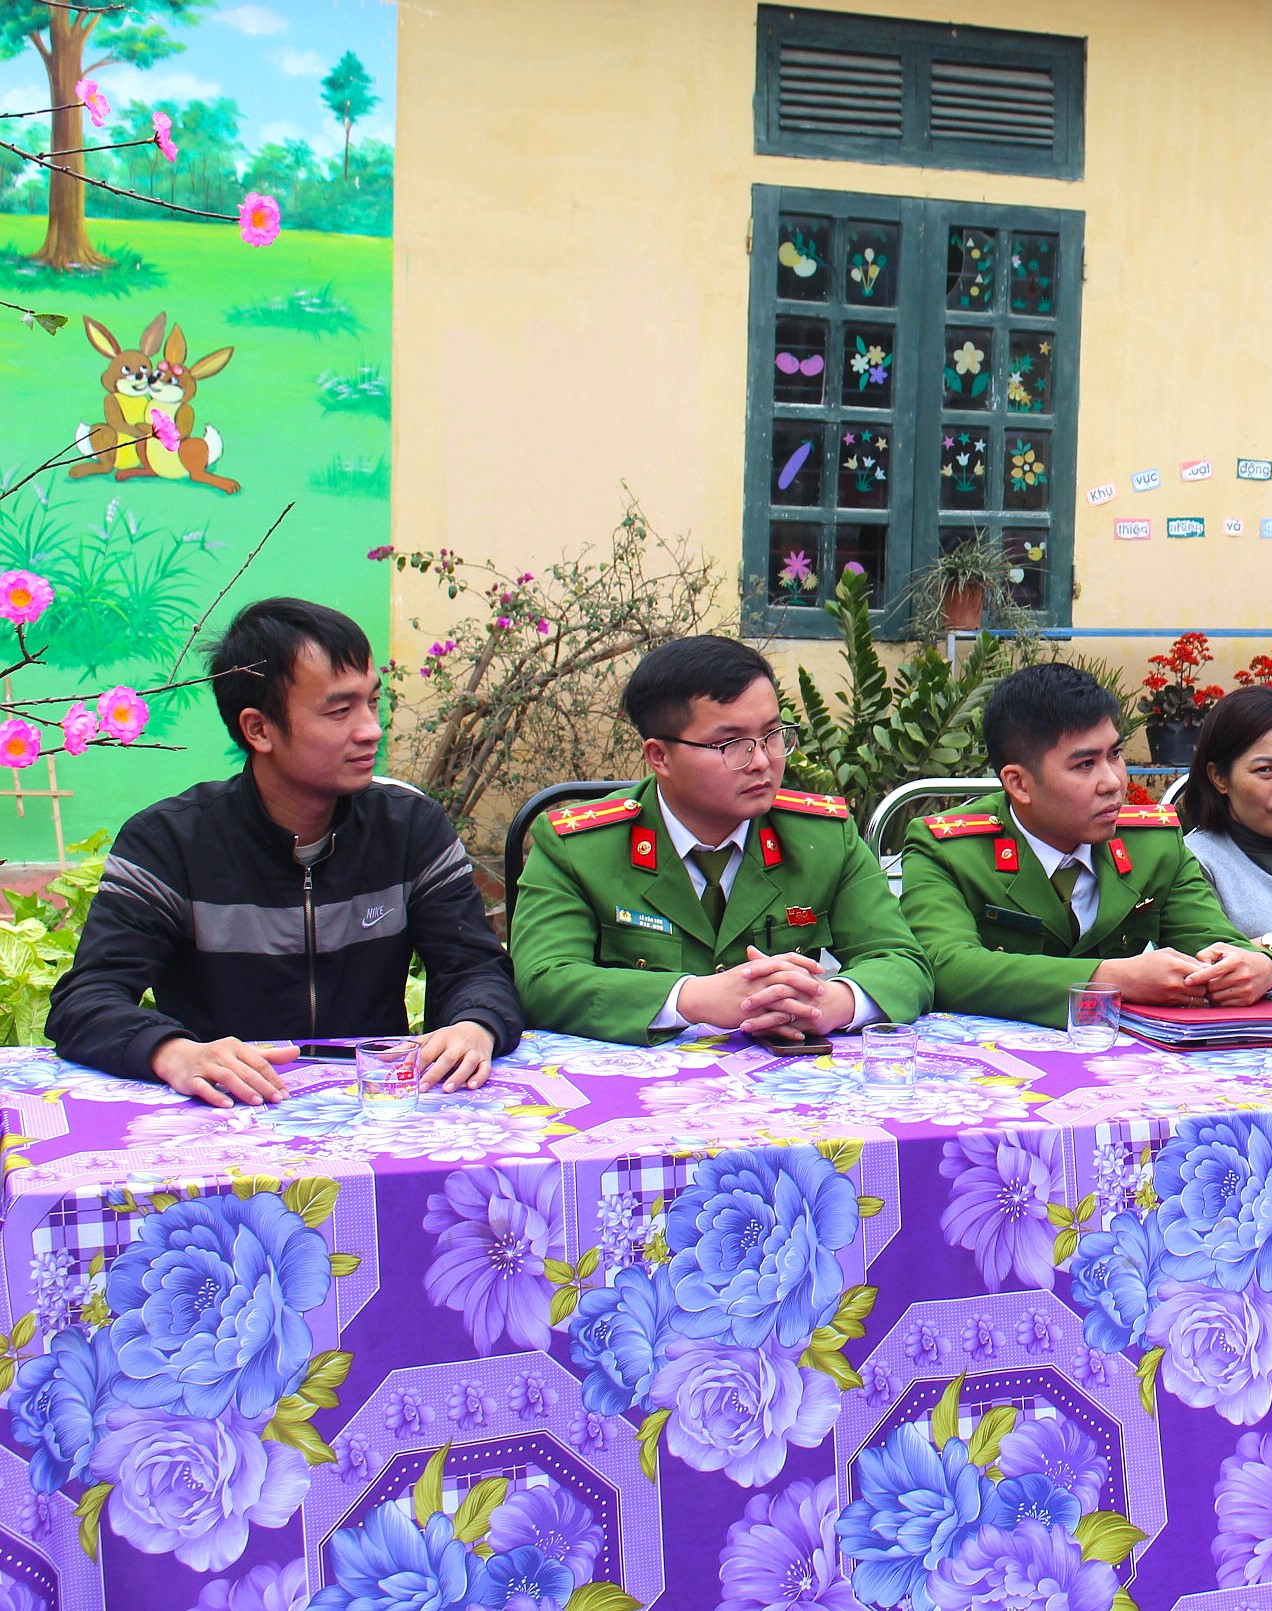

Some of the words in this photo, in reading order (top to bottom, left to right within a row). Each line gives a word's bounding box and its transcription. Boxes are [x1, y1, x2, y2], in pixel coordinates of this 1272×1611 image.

[1089, 486, 1114, 503] Khu
[1136, 472, 1159, 486] vực
[1239, 462, 1271, 478] động
[1118, 523, 1149, 537] thiện
[1226, 520, 1242, 532] và
[366, 905, 384, 918] NIKE
